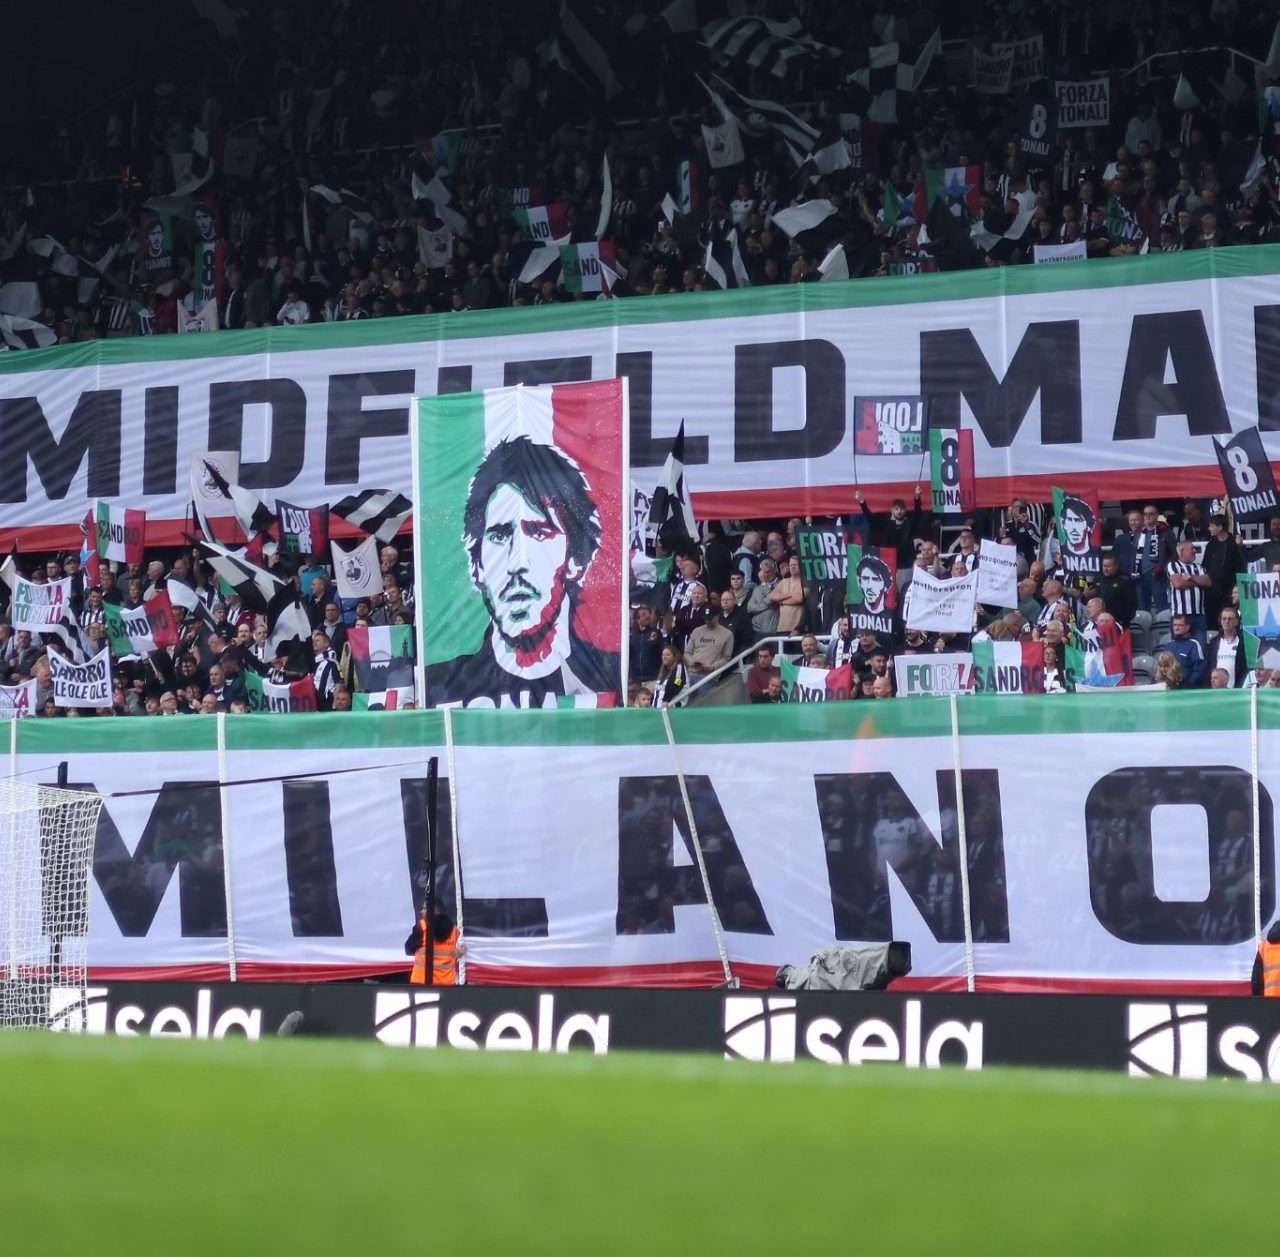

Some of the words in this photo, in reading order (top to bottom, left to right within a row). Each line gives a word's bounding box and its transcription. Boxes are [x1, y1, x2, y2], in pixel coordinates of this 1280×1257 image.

[1058, 84, 1107, 104] FORZA
[1029, 104, 1048, 139] 8
[1058, 104, 1108, 122] TONALI
[940, 438, 960, 487] 8
[1226, 446, 1258, 492] 8
[1233, 490, 1277, 514] TONALI
[802, 557, 848, 581] TONA
[1065, 556, 1101, 573] ONALI
[851, 613, 892, 634] TONALI
[51, 657, 107, 683] SANDRO
[975, 665, 1045, 693] SANDRO
[55, 682, 67, 696] LE
[68, 684, 88, 699] OLE
[89, 683, 108, 700] OLE
[37, 765, 1277, 945] MILANO
[114, 988, 261, 1041] sela
[437, 993, 610, 1055] sela
[805, 1000, 984, 1069] sela
